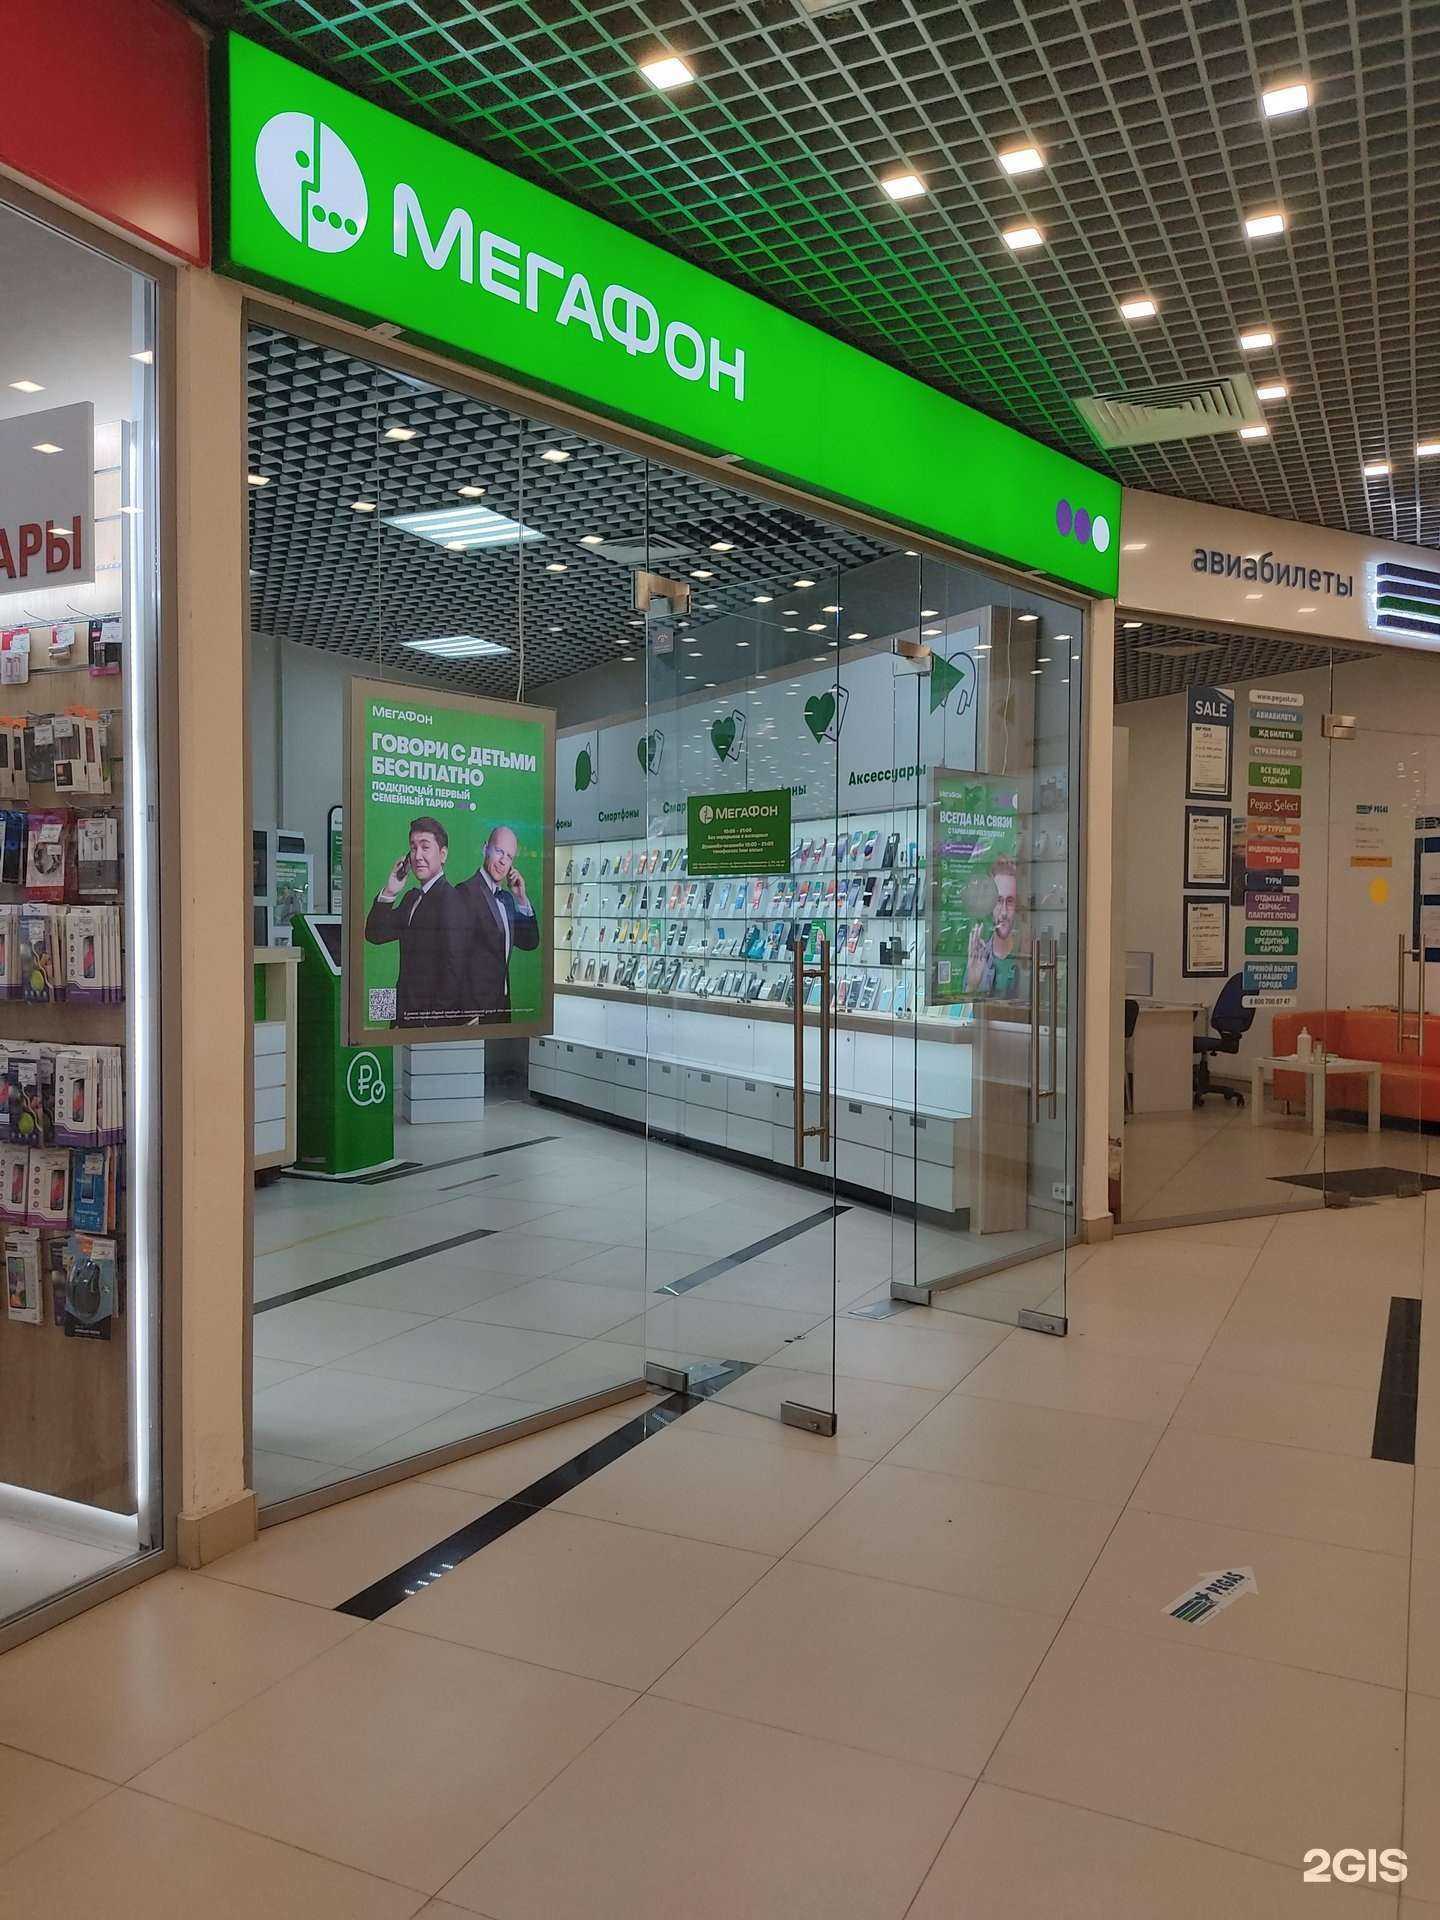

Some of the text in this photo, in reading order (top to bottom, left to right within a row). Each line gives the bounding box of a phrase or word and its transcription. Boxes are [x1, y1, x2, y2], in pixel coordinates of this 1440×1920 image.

[1192, 547, 1353, 598] авиабилеты
[1195, 700, 1228, 718] SALE
[1255, 711, 1297, 722] АВИАБИЛЕТЫ
[371, 732, 537, 772] ГОВОРИ С ДЕТЬМИ
[371, 756, 485, 787] БЕСПЛАТНО
[848, 764, 926, 786] Аксессуары
[1260, 765, 1291, 776] ВСЕ ВИДЫ
[1262, 776, 1288, 785] ОТДЫХА
[371, 780, 471, 800] ПОДКЛЮЧАЙ ПЕРВЫЙ
[371, 792, 455, 810] СЕМЕЙНЫЙ ТАРИФ
[1249, 798, 1299, 812] Pegas Select
[598, 809, 640, 823] Смартфоны
[940, 810, 1013, 829] ВСЕГДА НА СВЯЗИ
[1265, 855, 1282, 864] ТУРЫ
[1265, 876, 1282, 885] ТУРЫ
[1254, 894, 1291, 903] ОТДЫХАЙТЕ
[1248, 911, 1296, 920] ПЛАТИТЕ ПОТОМ
[1254, 936, 1289, 945] КРЕДИТНОЙ
[1259, 945, 1283, 953] КАРТОЙ
[1247, 963, 1294, 973] ПРЯМОЙ ВЫЛЕТ
[1258, 980, 1283, 988] ГОРОДА
[1205, 1571, 1245, 1595] PEGAS
